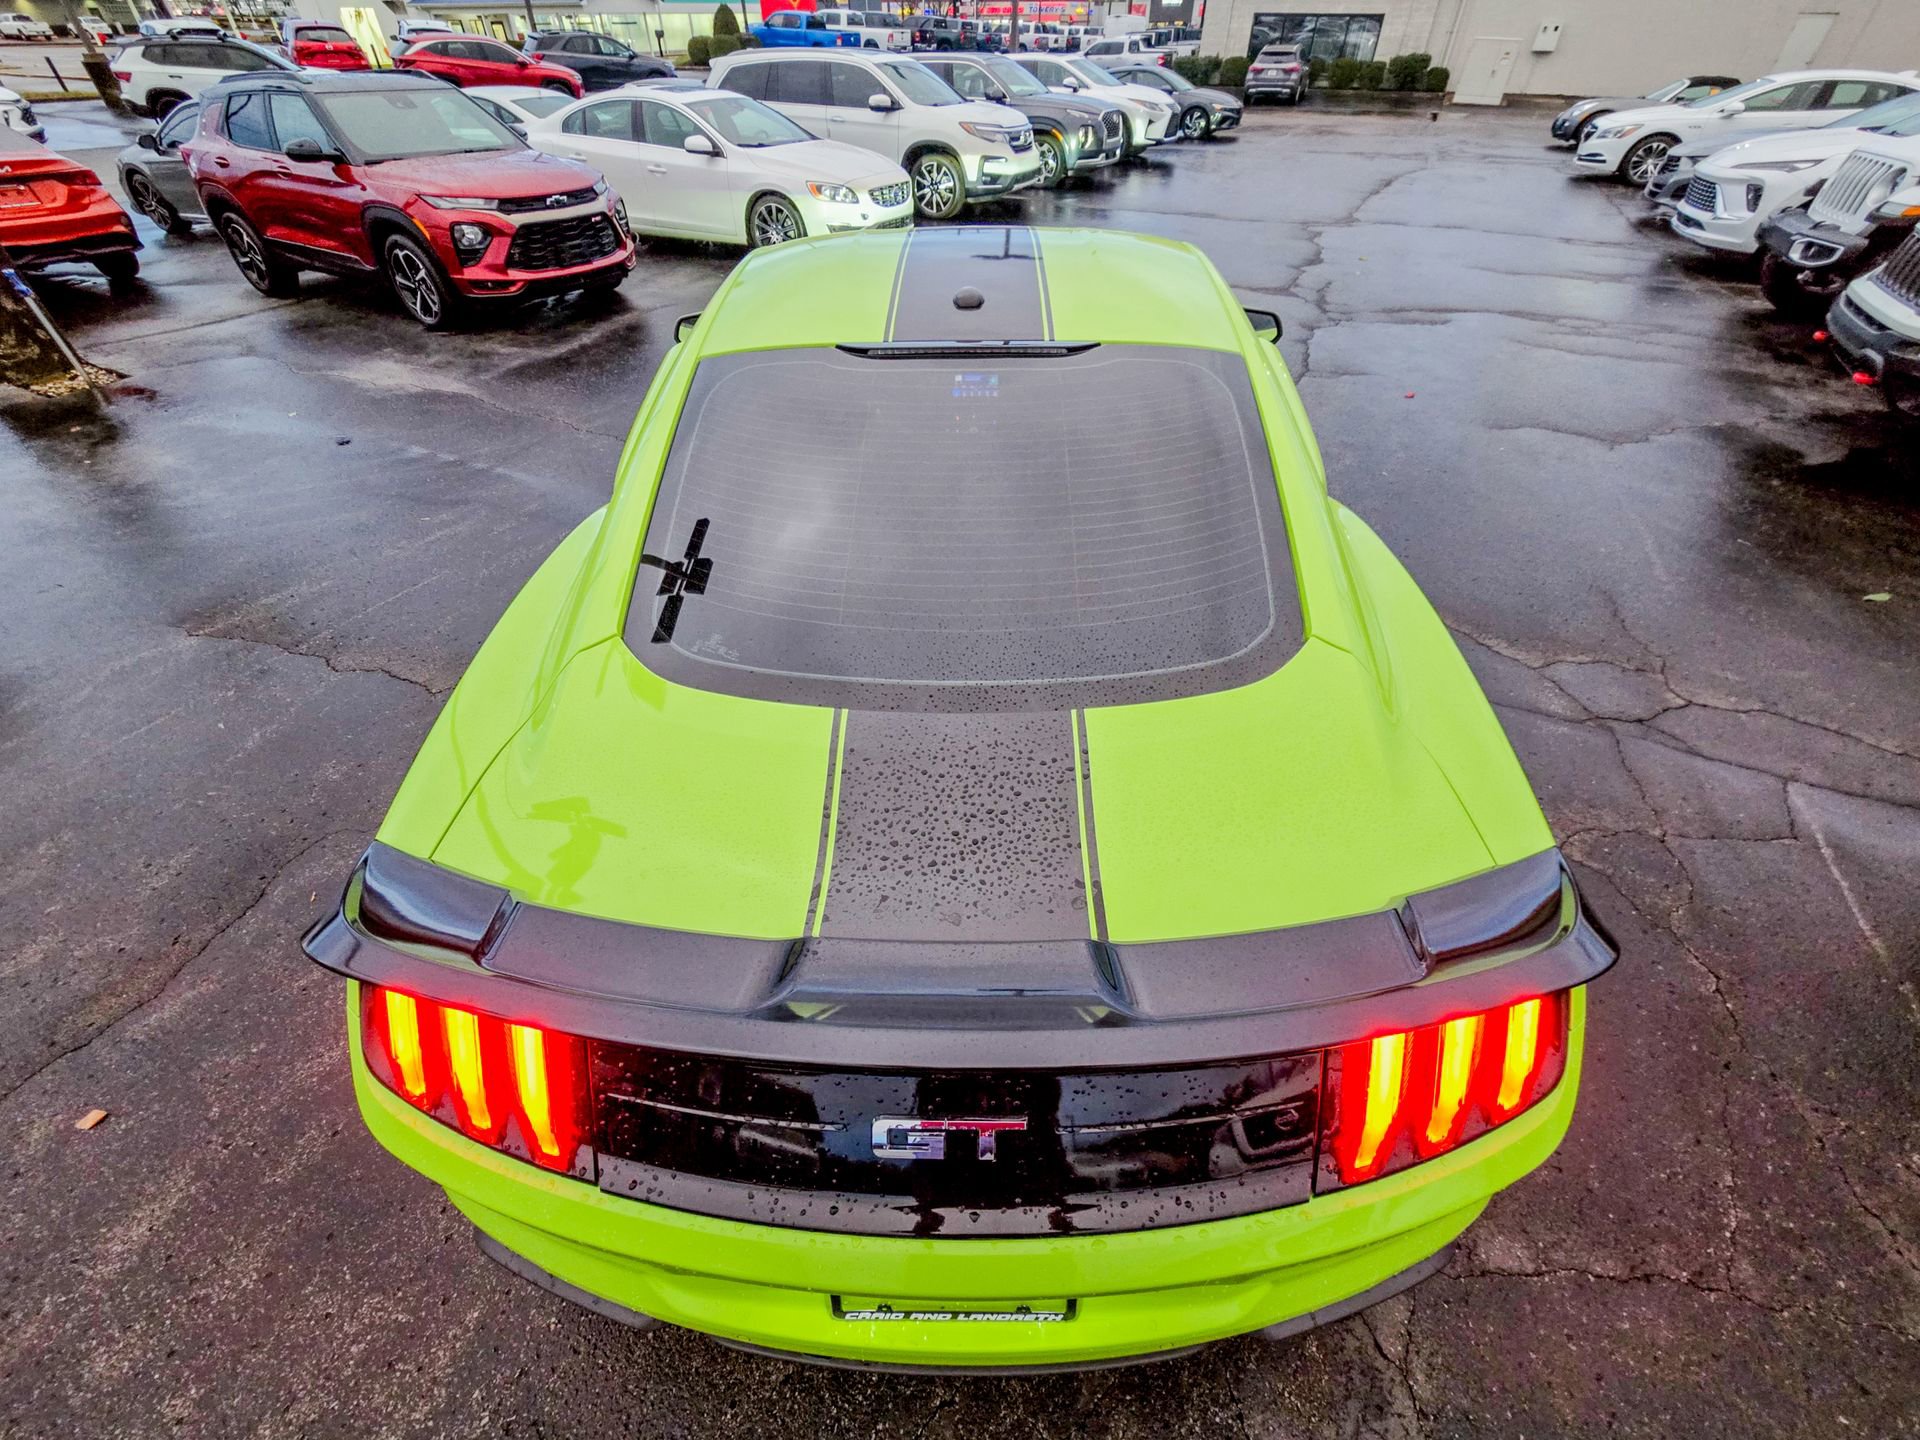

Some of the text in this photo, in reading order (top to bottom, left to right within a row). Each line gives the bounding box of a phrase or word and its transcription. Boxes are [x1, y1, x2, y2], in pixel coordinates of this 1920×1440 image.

[872, 1116, 1028, 1161] GT
[909, 1312, 952, 1320] AND
[956, 1313, 1064, 1321] LANDRETH
